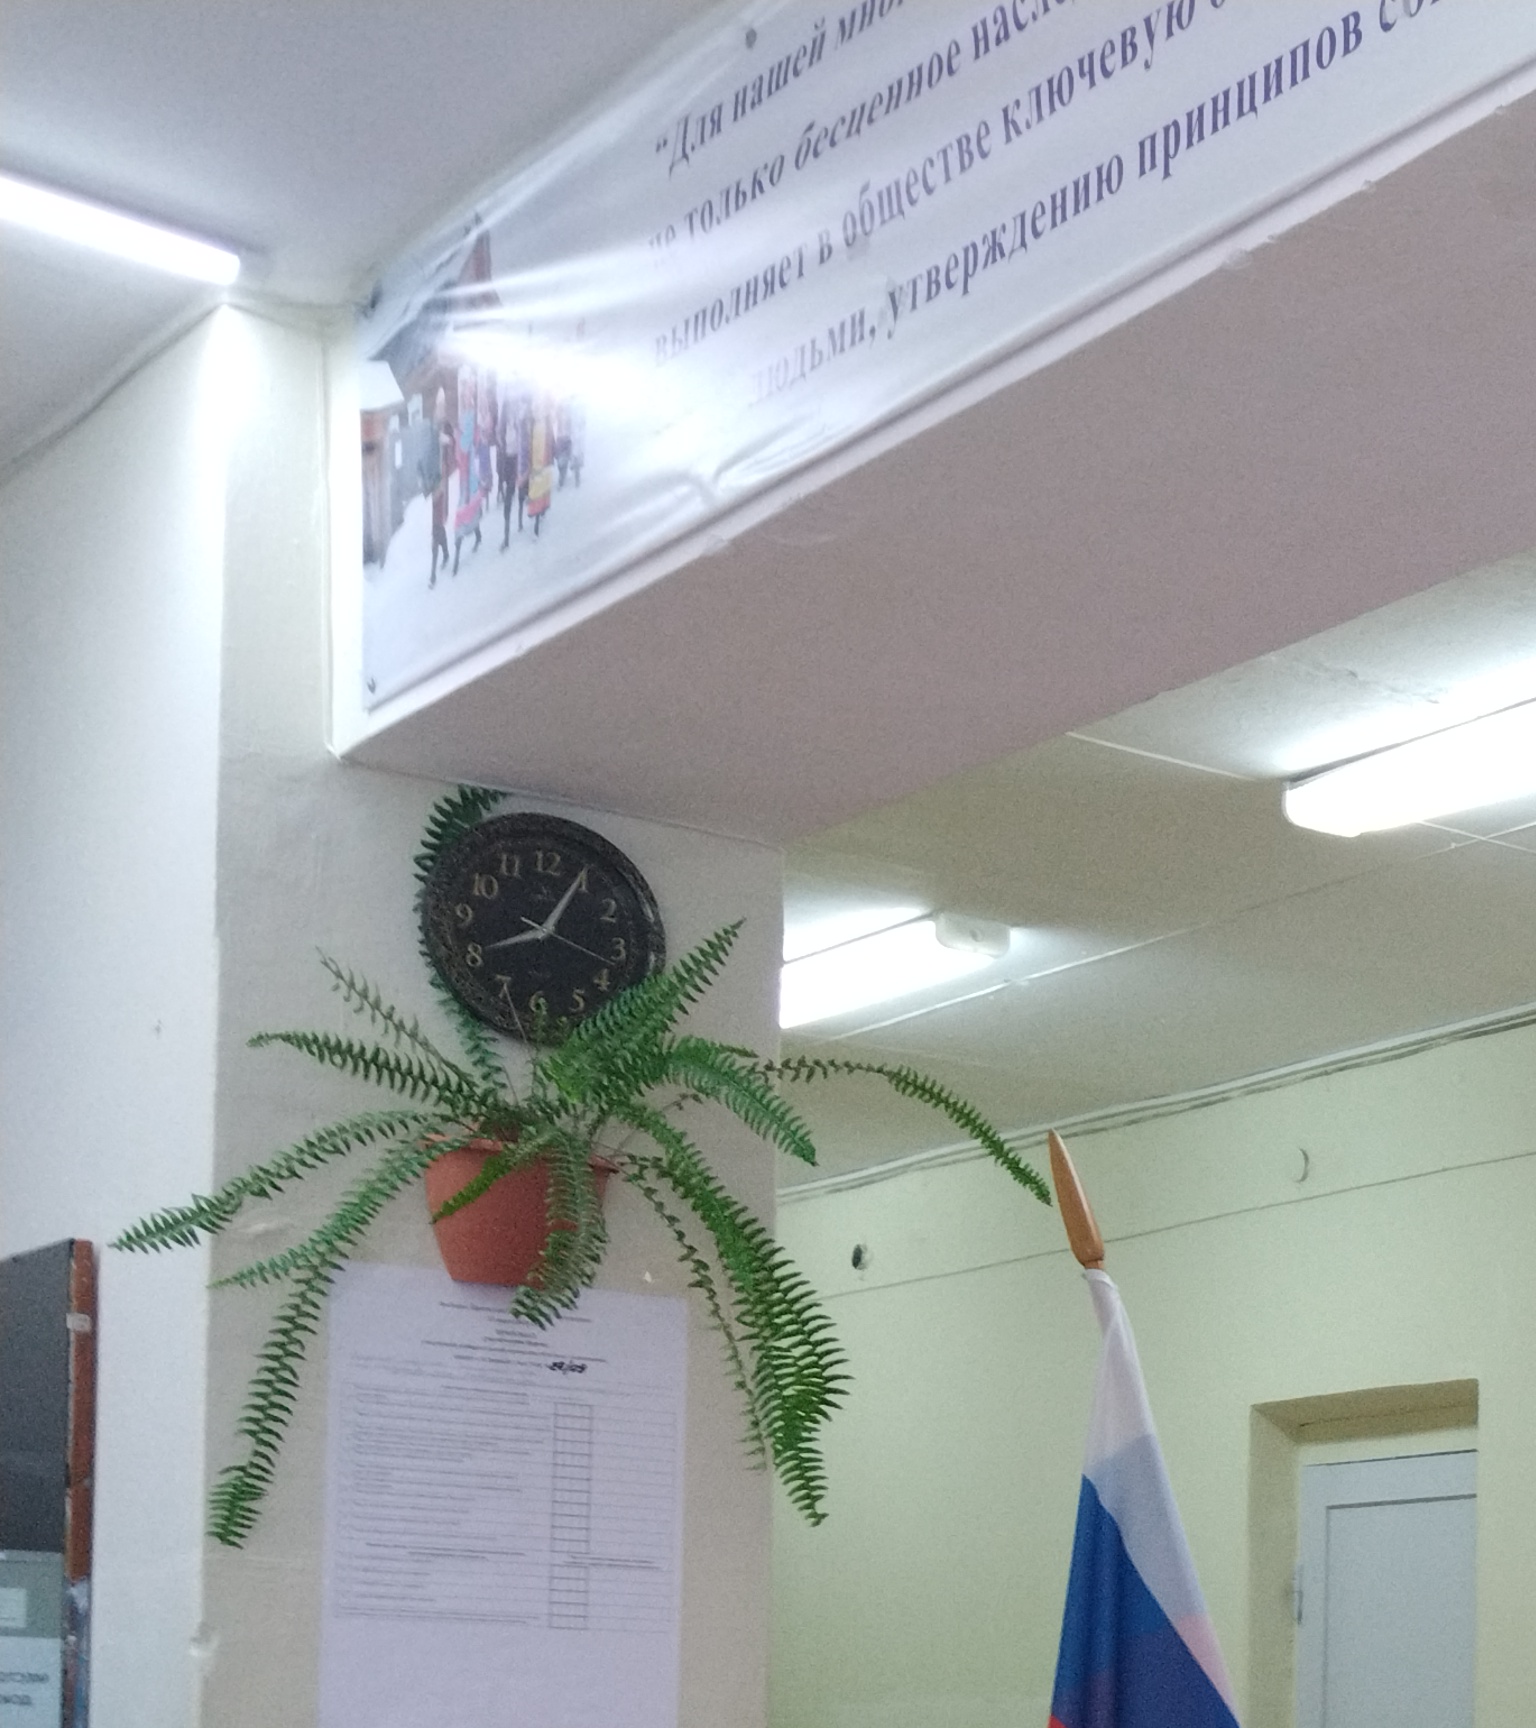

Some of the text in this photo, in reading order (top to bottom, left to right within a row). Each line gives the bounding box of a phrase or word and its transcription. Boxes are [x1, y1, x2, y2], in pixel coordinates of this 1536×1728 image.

[733, 17, 827, 123] нашей
[684, 153, 786, 240] только
[794, 38, 961, 172] бесценное
[653, 0, 1195, 368] выполняет в обществе ключевую
[886, 153, 1125, 341] утверждению
[1138, 10, 1364, 180] принципов
[534, 851, 561, 876] 12
[472, 873, 499, 899] 10
[455, 903, 474, 927] 9
[600, 899, 617, 923] 2
[466, 943, 483, 967] 8
[611, 937, 627, 962] 3
[593, 968, 610, 992] 4
[569, 989, 586, 1012] 5
